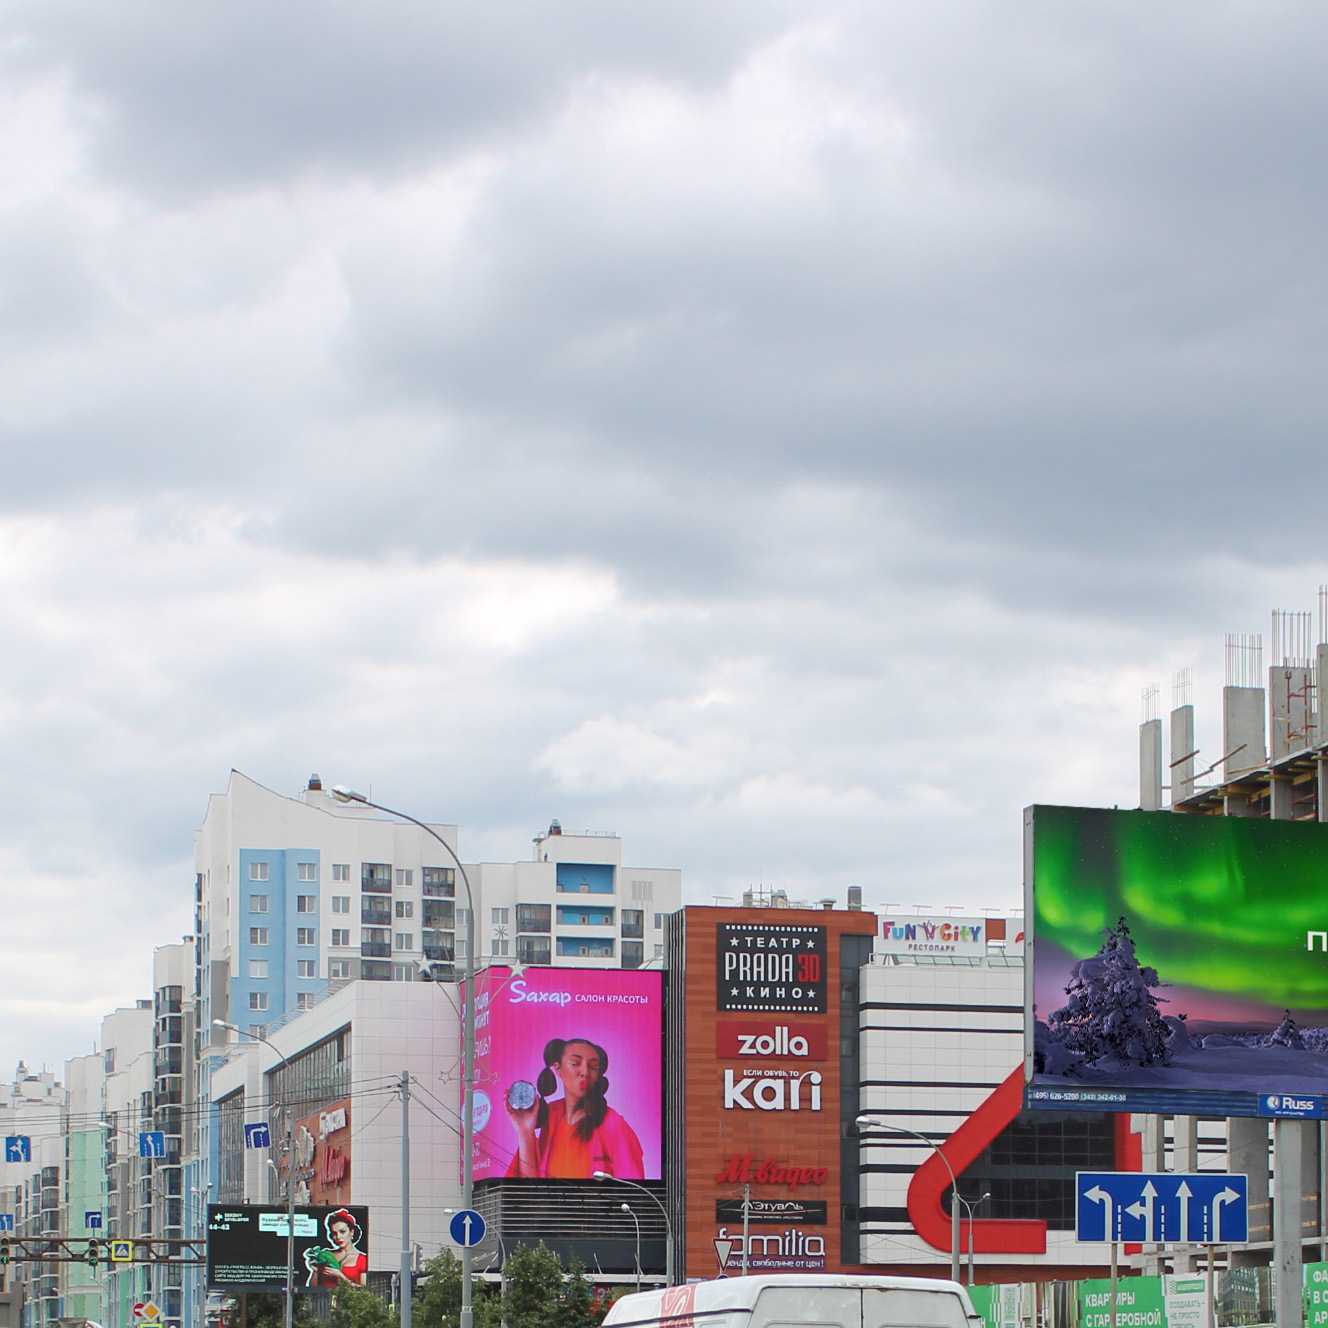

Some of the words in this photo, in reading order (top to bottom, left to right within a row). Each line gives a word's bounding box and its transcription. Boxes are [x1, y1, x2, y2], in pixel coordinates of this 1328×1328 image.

[745, 936, 801, 948] ТЕАТР
[908, 943, 956, 952] РЕСТОПАРК
[724, 951, 793, 982] PRADA
[798, 953, 822, 982] 3D
[575, 994, 605, 1003] САЛОН
[607, 995, 648, 1004] КРАСОТЫ
[746, 986, 803, 999] КИНО
[737, 1026, 809, 1056] zolla
[724, 1069, 823, 1111] kari
[1282, 1096, 1314, 1110] Russ
[1314, 1291, 1321, 1303] В
[1094, 1307, 1162, 1328] ГАРЕРОБНОЙ
